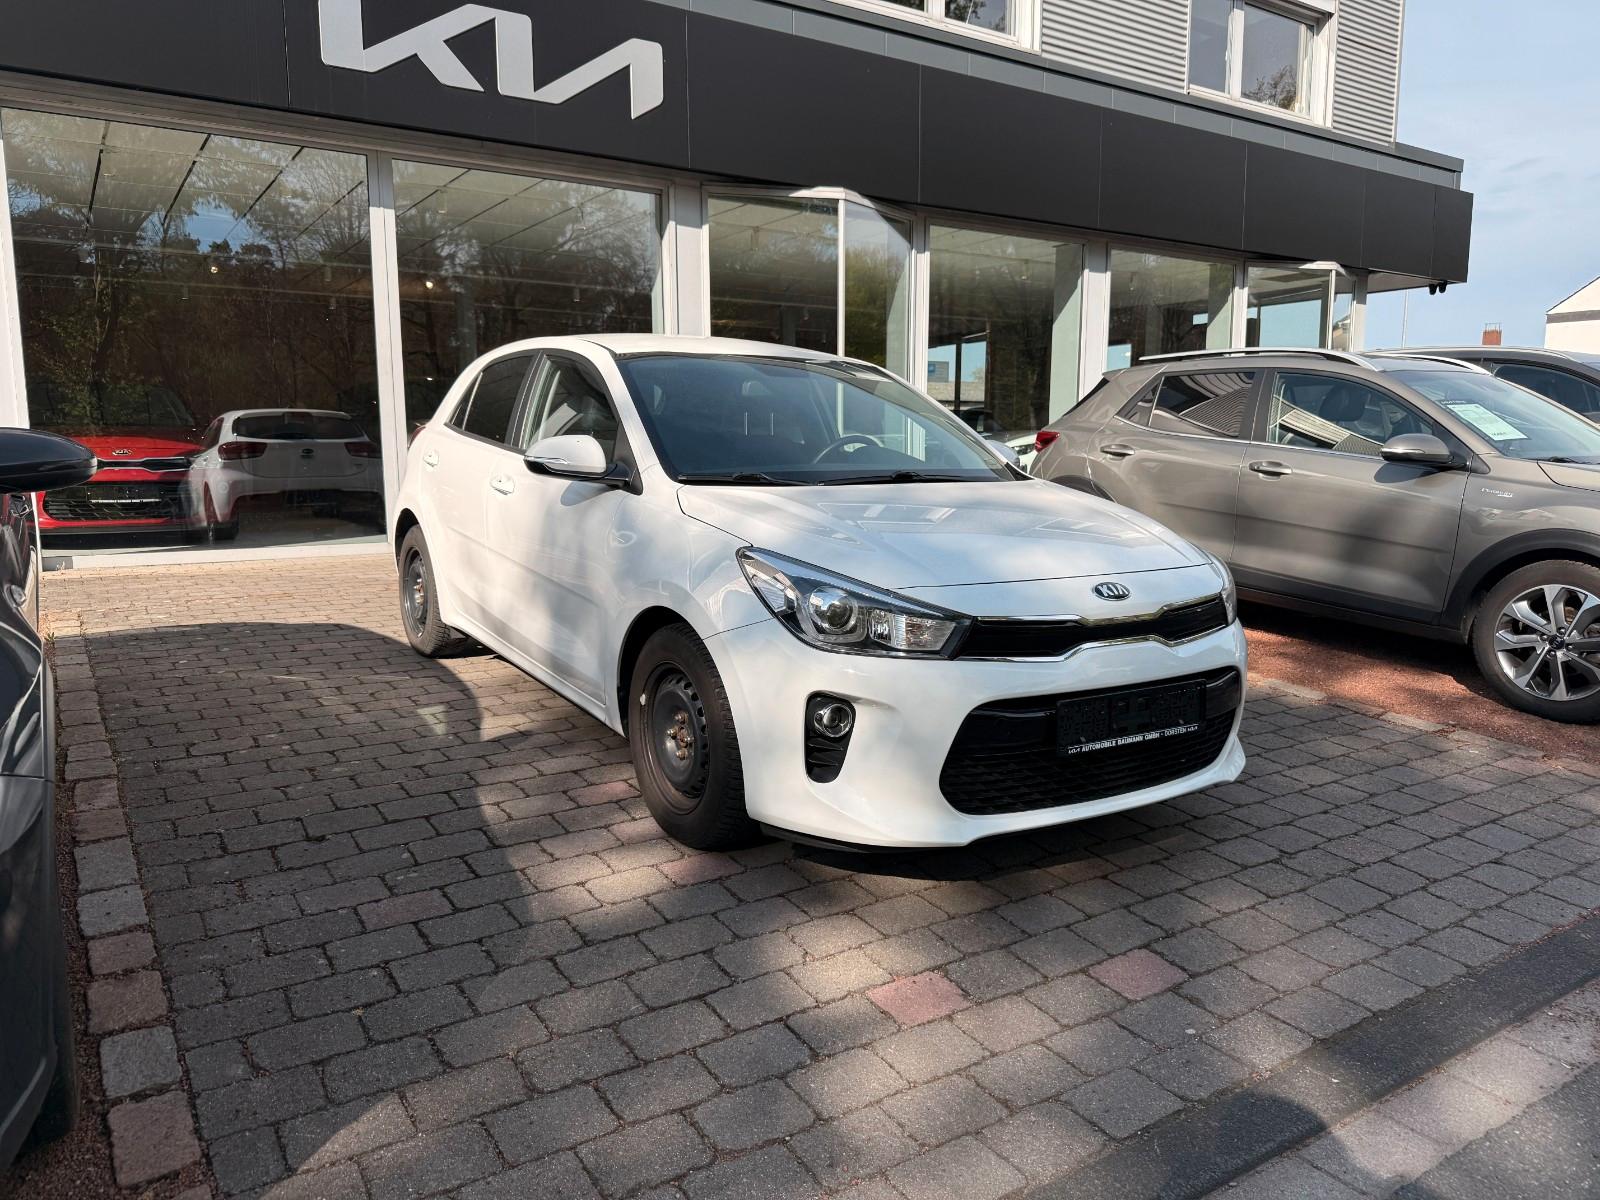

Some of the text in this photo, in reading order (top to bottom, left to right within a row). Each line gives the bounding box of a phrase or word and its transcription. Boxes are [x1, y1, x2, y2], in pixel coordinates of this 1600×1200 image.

[1096, 583, 1129, 598] KIA
[1081, 740, 1116, 752] AUTOMOBILE
[1165, 727, 1187, 737] DORSTEN
